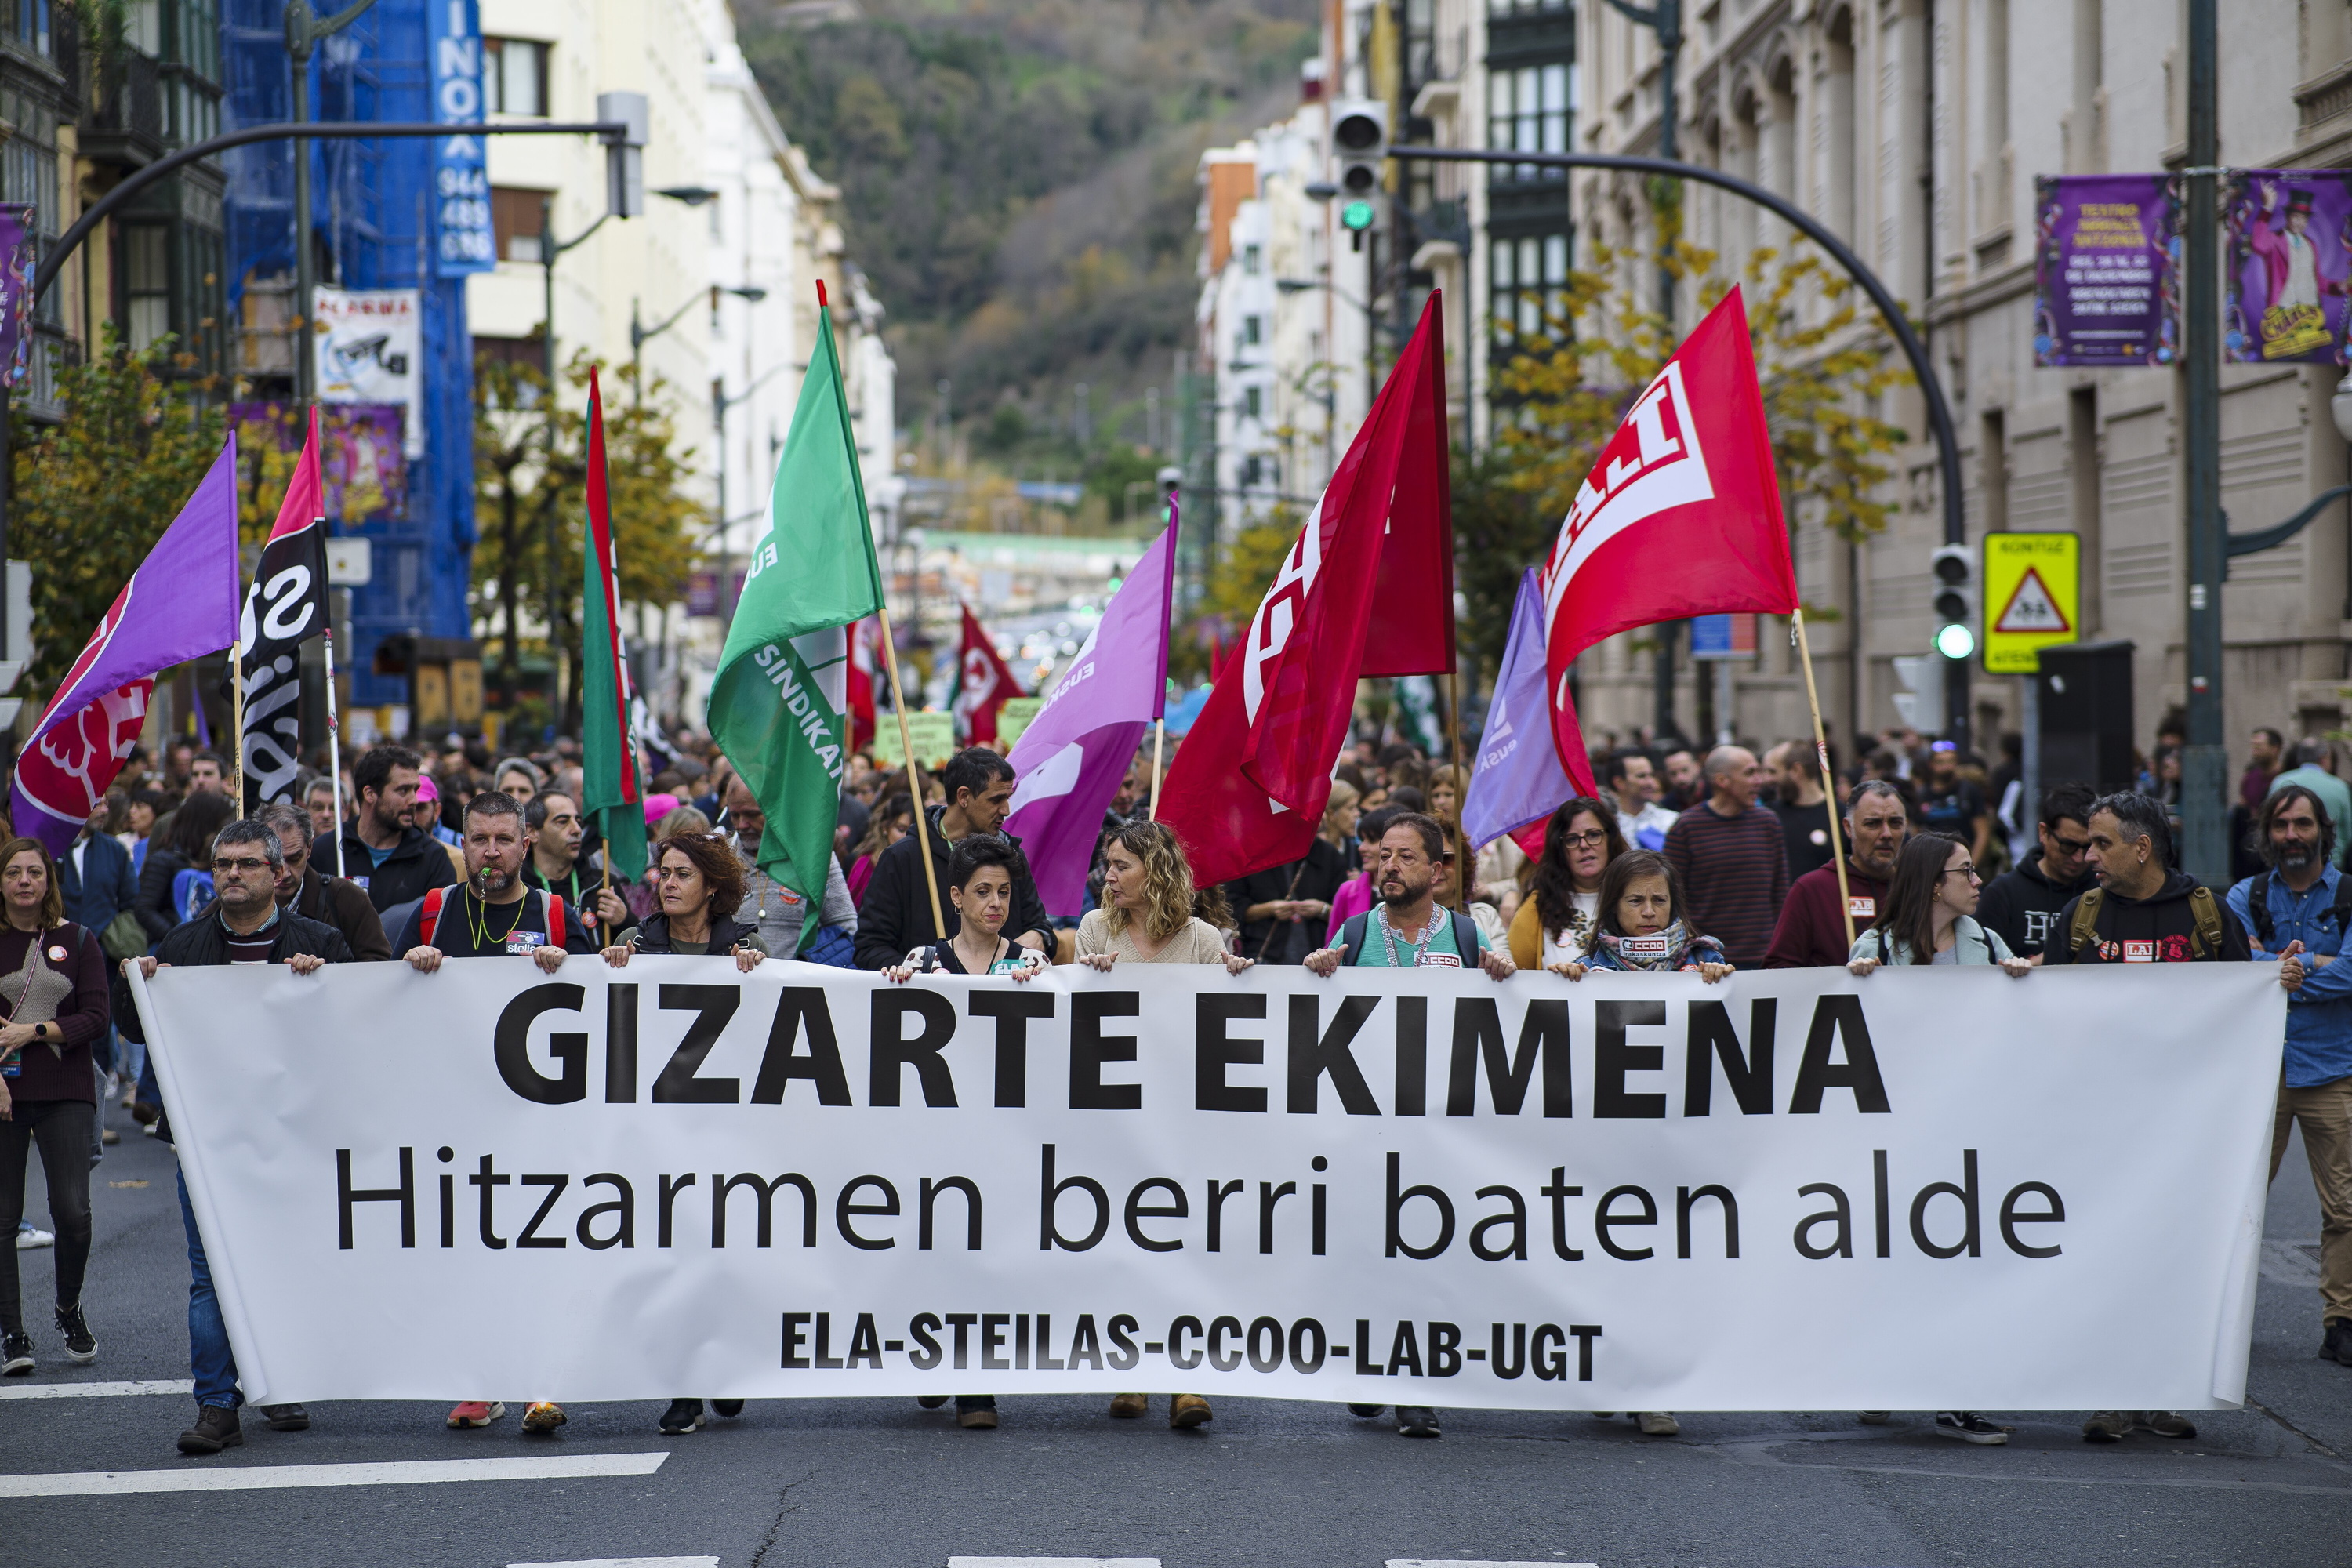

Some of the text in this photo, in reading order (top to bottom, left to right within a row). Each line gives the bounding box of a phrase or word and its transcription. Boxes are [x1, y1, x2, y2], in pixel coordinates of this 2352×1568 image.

[1430, 956, 1458, 965] CCOO
[494, 982, 1891, 1119] GIZARTE EKIMENA
[336, 1143, 2065, 1261] Hitzarmen berri baten alde
[782, 1312, 1602, 1381] ELA-STEILAS-CCOO-LAB-UGT
